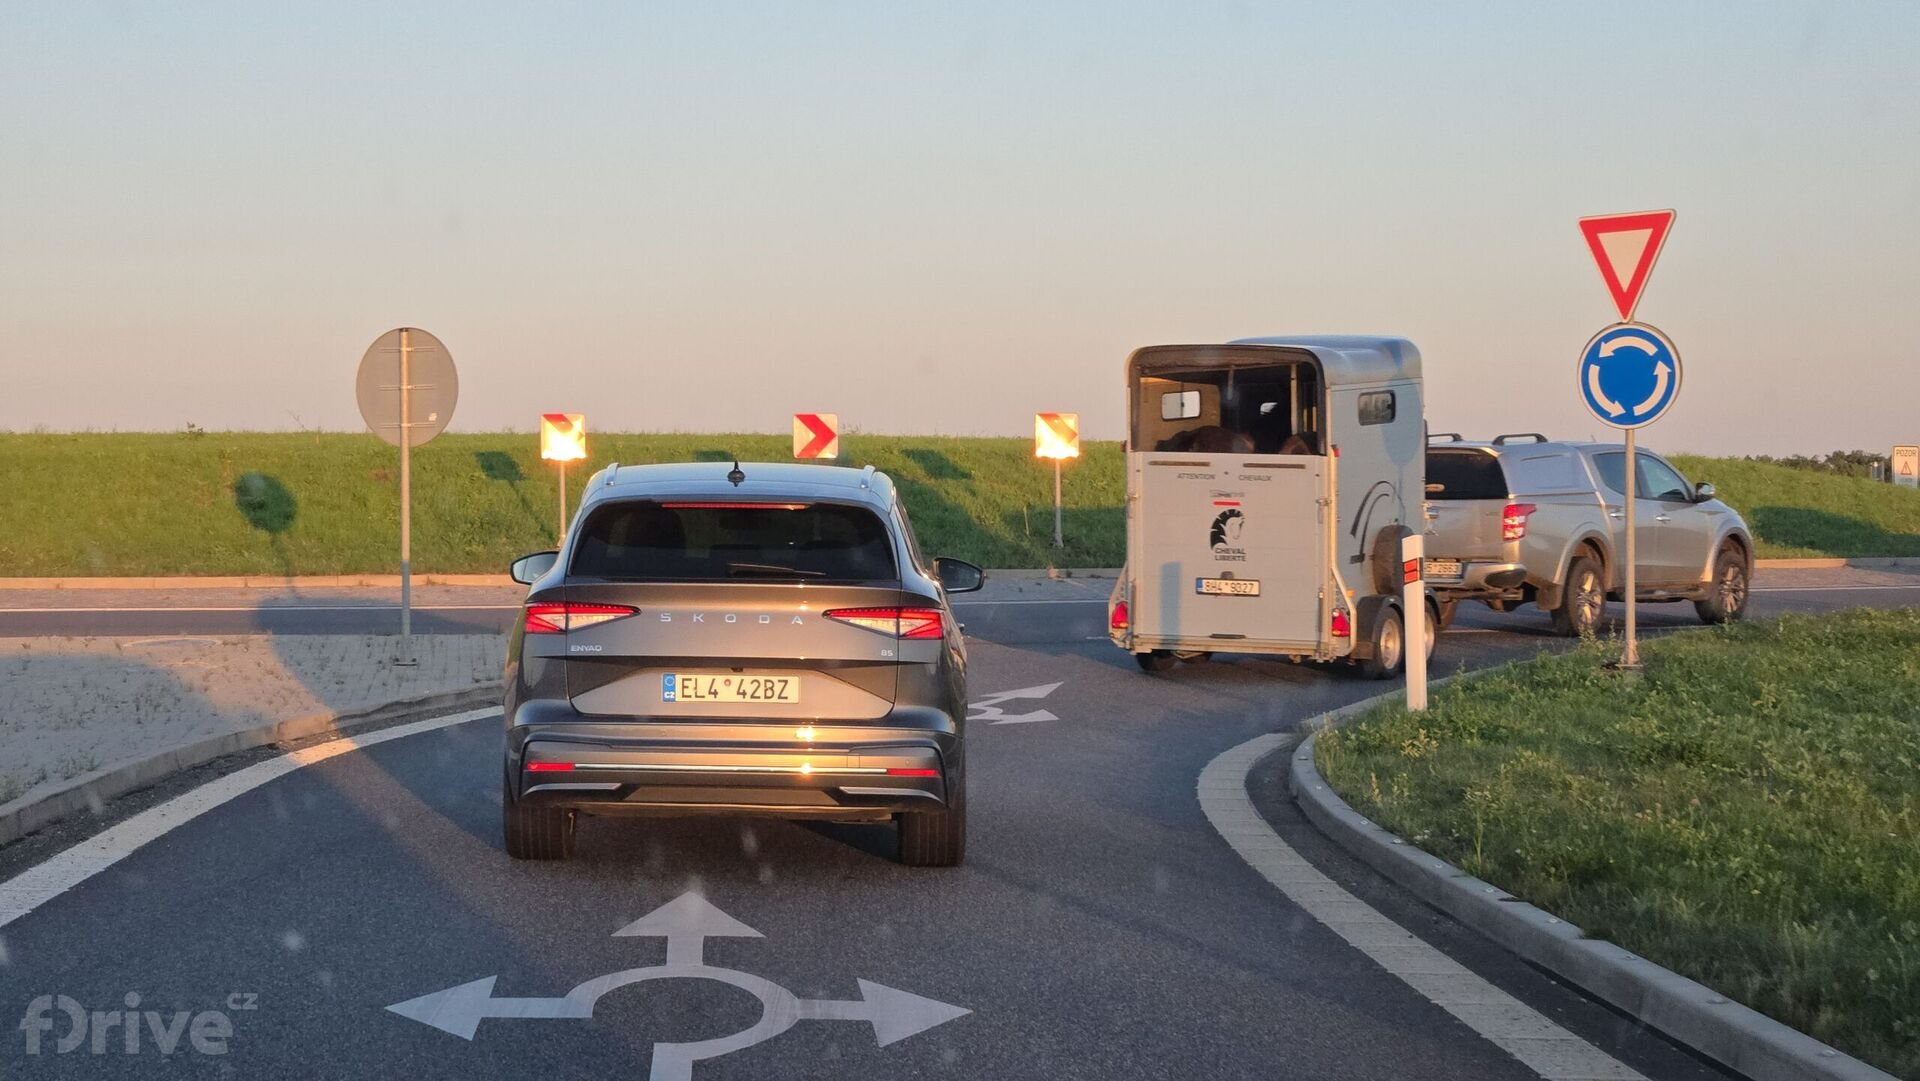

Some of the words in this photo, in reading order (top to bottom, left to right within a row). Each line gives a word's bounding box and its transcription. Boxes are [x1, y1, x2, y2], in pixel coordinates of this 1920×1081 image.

[1895, 449, 1917, 457] POZOR
[1230, 582, 1255, 594] 9327
[880, 649, 894, 657] 85
[681, 677, 719, 699] EL4
[736, 679, 789, 700] 42BZ
[664, 691, 675, 699] CZ
